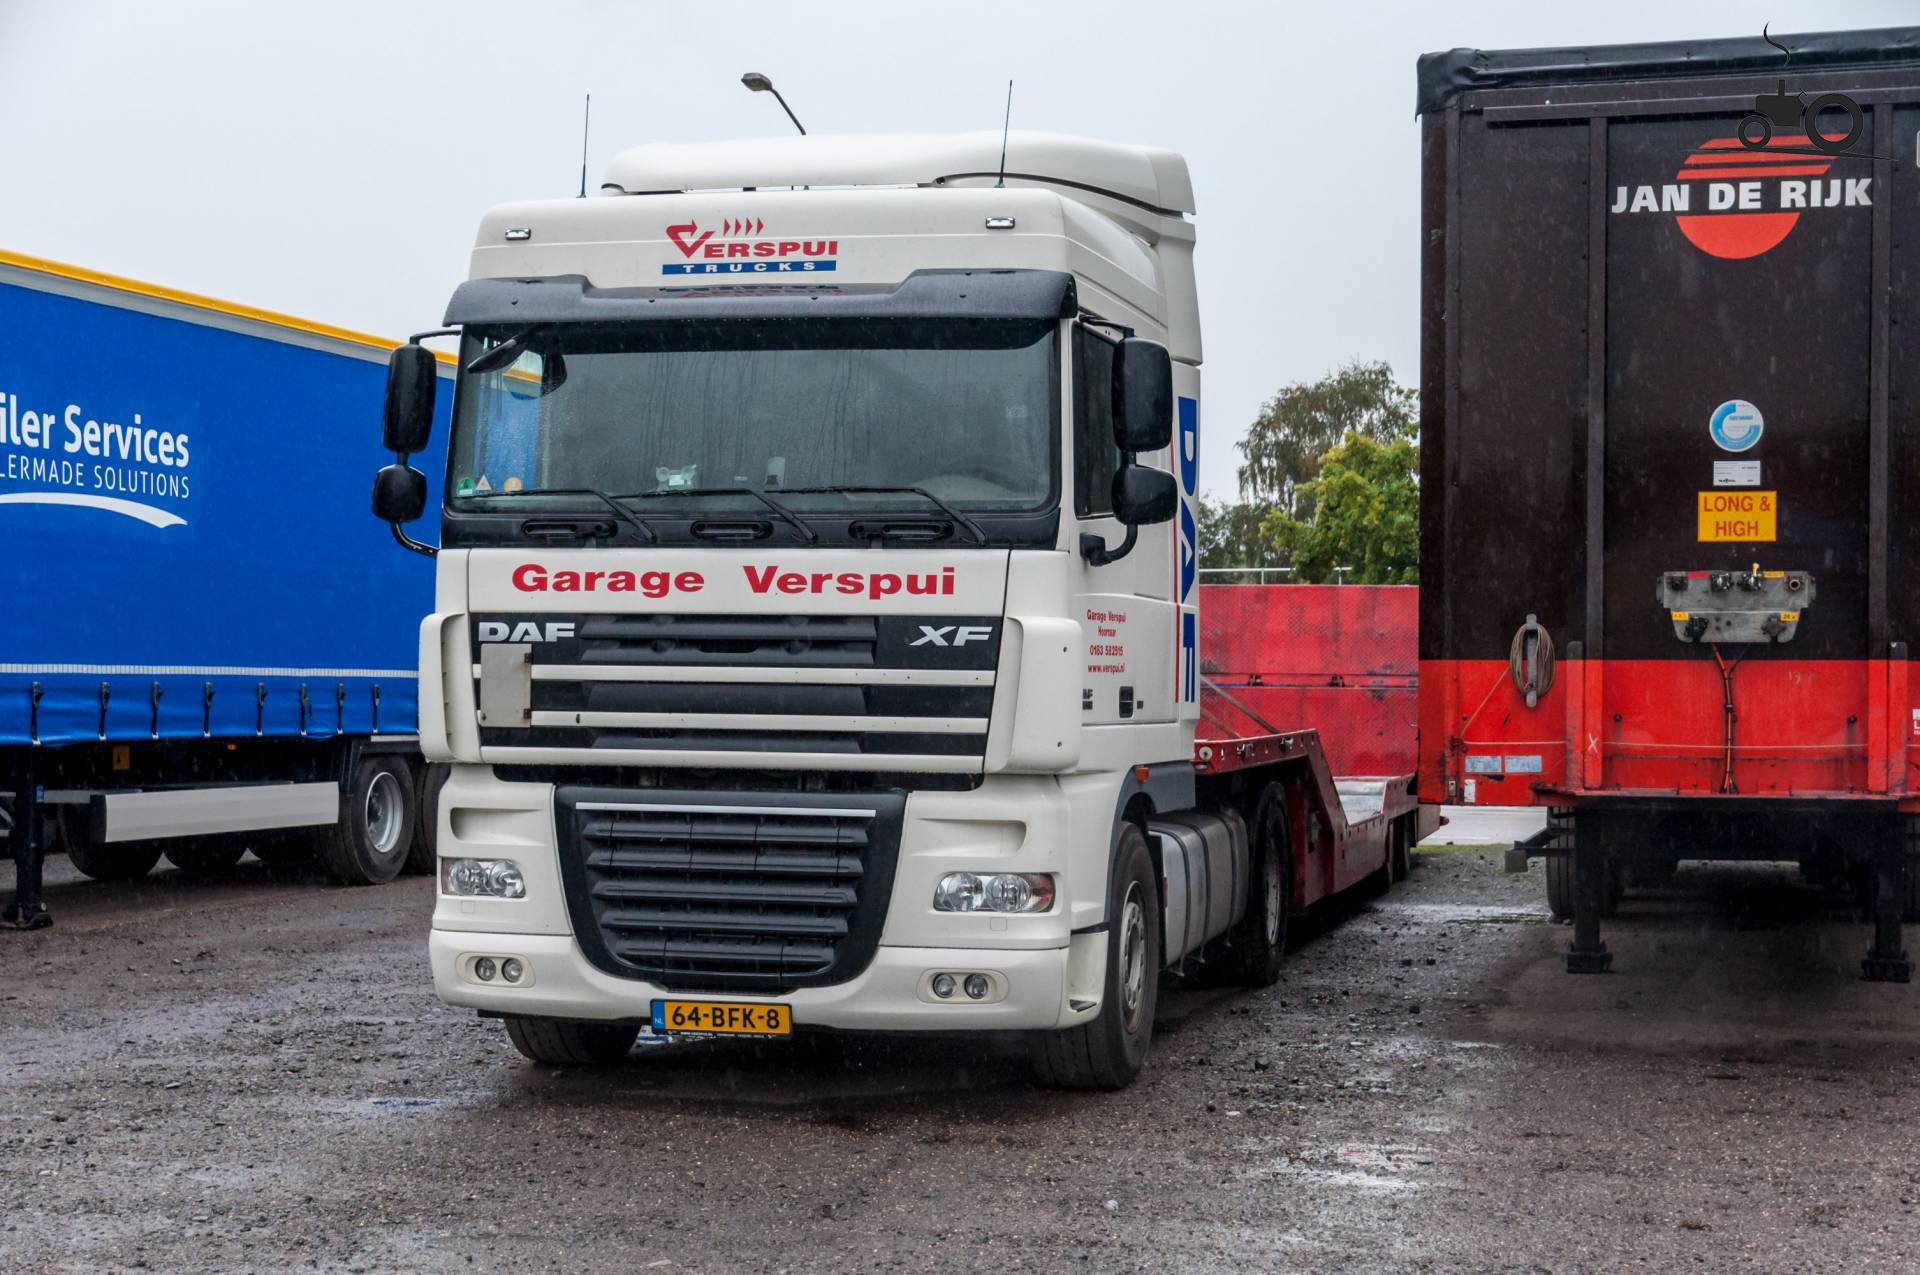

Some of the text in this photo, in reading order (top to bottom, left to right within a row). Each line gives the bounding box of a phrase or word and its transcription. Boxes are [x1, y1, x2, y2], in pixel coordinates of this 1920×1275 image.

[1611, 178, 1873, 214] JAN DE RIJK
[666, 220, 838, 259] VERSPUI
[683, 262, 816, 273] TRUCKS
[63, 404, 190, 468] Services
[93, 465, 190, 499] SOLUTIONS
[1703, 496, 1771, 513] LONG &
[1715, 520, 1759, 537] HIGH
[1177, 396, 1197, 703] DAF
[511, 563, 955, 600] Garage Verspui
[1087, 609, 1107, 623] Garage
[478, 621, 576, 642] DAF
[909, 625, 993, 647] XF
[654, 1017, 665, 1025] NL
[672, 1005, 780, 1030] 64-BFK-8
